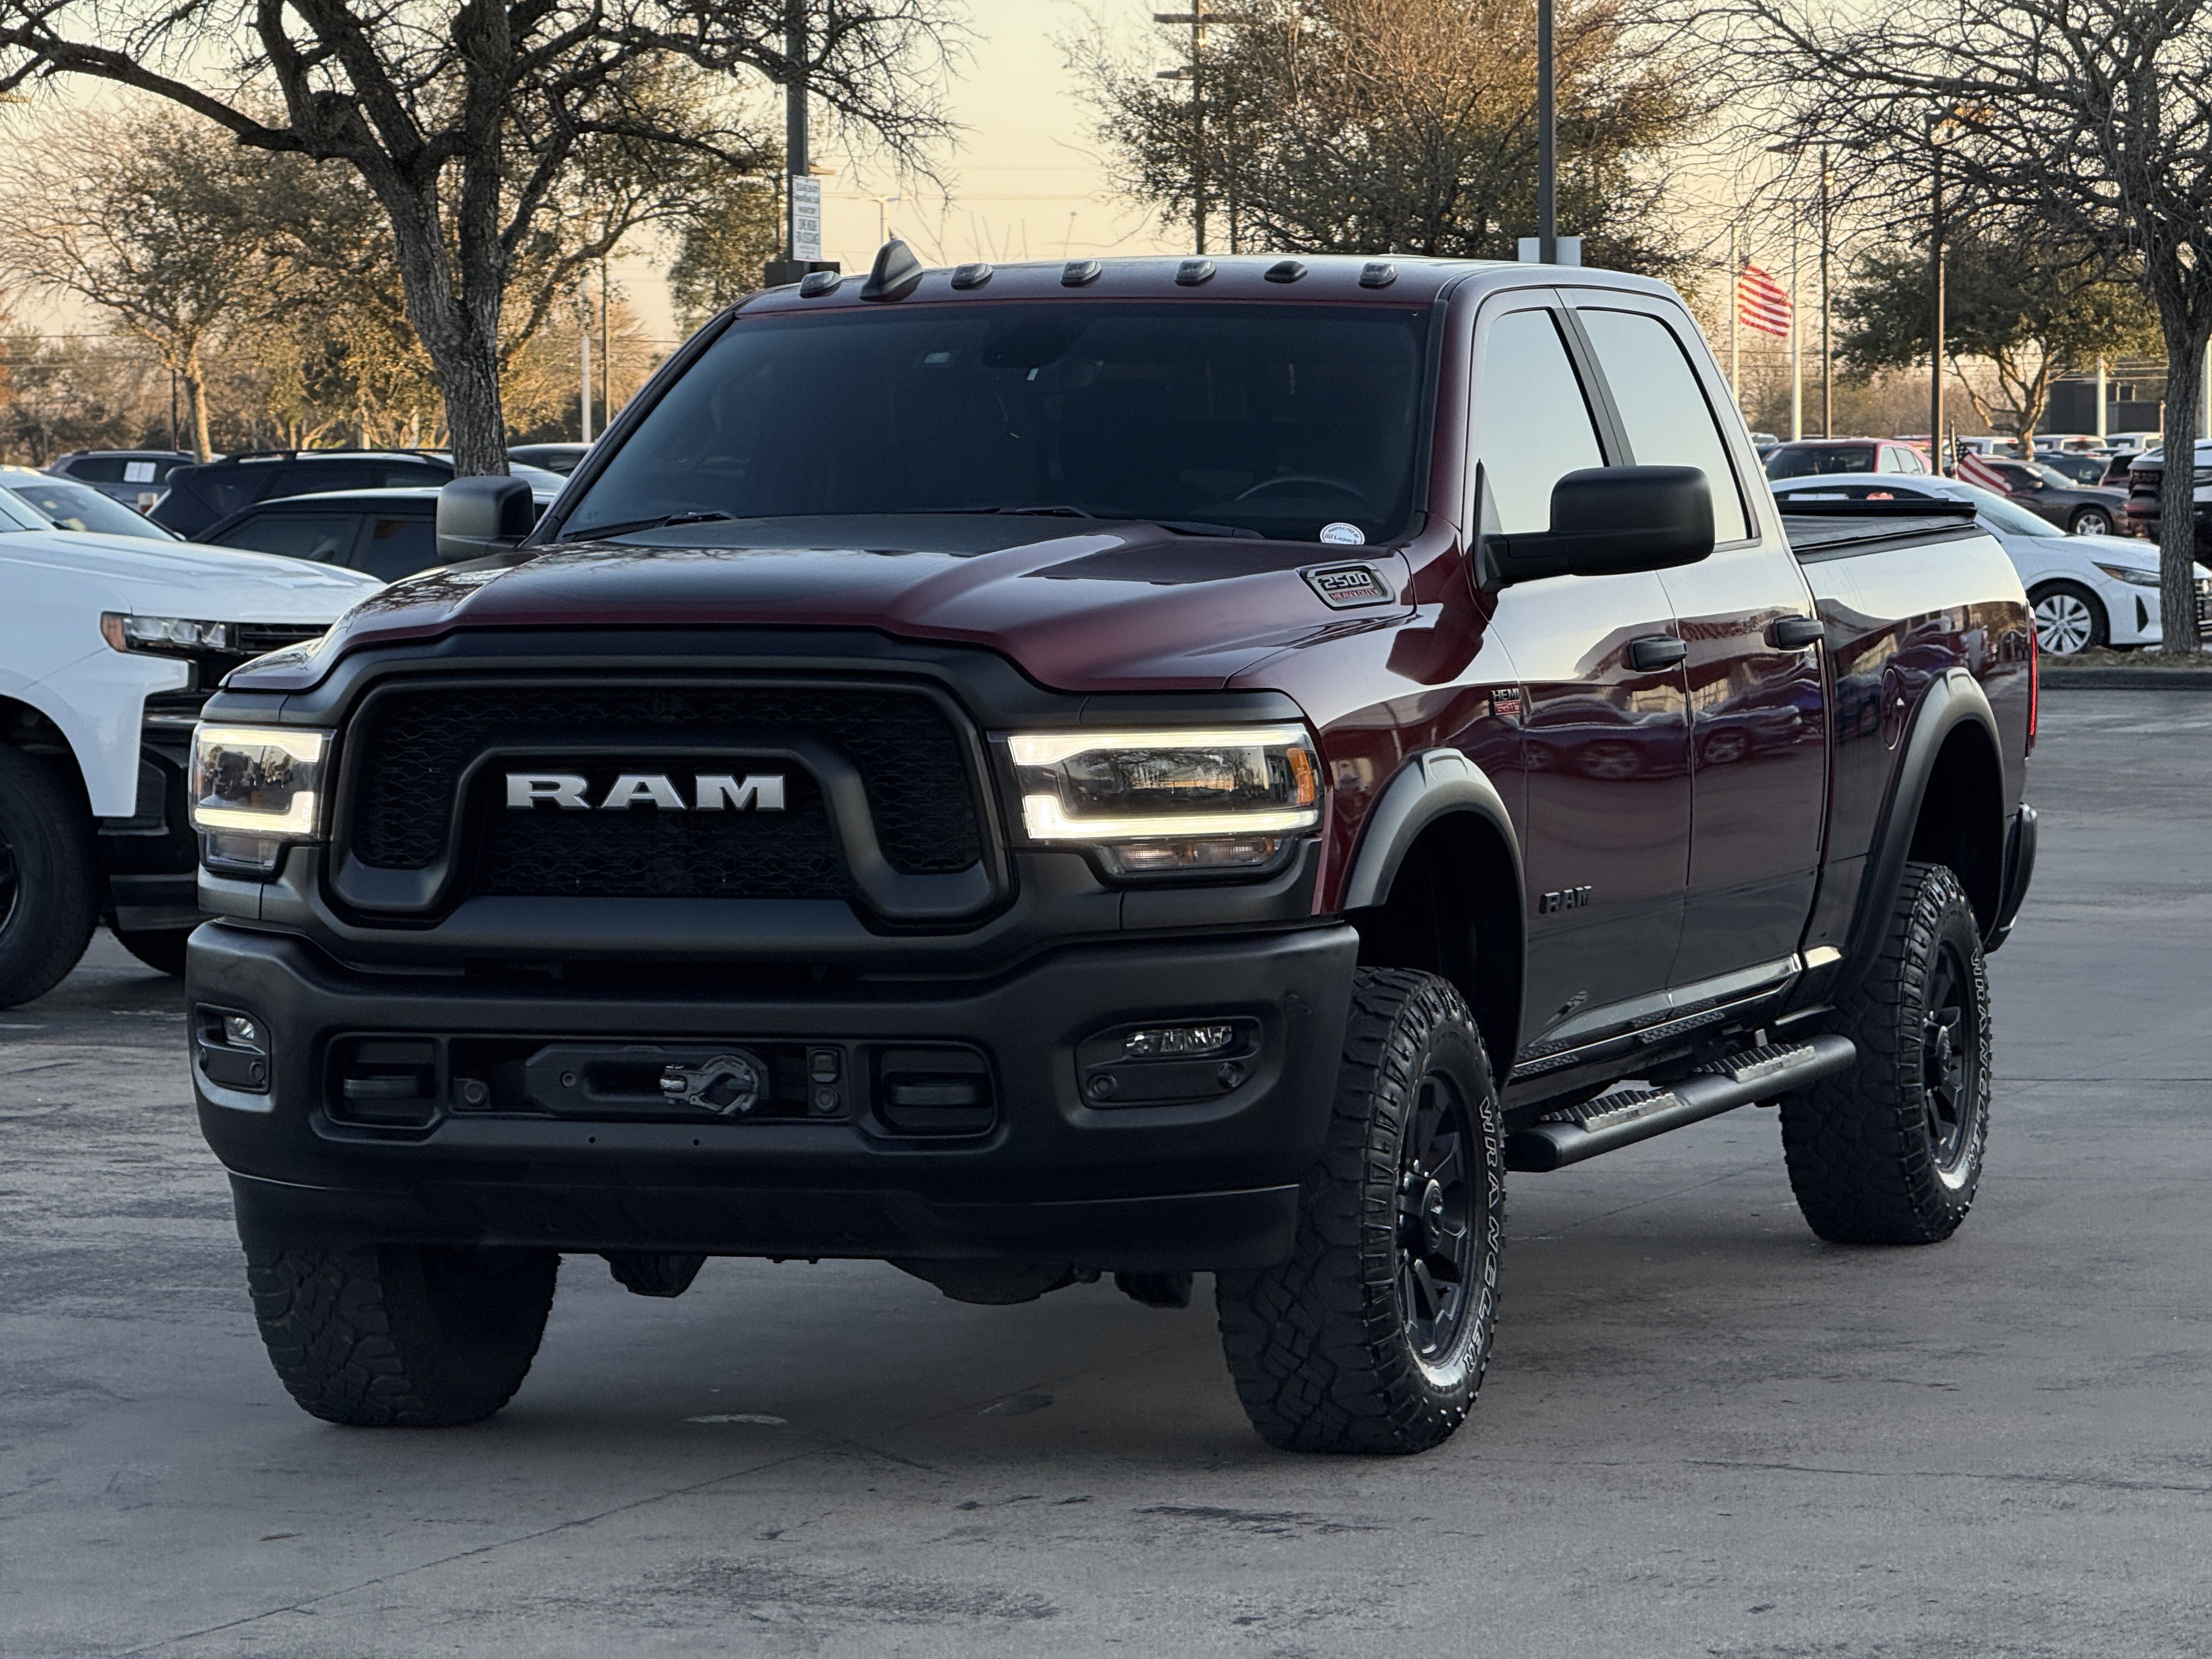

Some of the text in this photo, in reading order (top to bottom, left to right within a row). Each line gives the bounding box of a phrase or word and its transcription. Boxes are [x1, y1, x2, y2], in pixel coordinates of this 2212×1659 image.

[1320, 572, 1372, 590] 2500
[1329, 588, 1379, 600] HEAVY DUTY
[1490, 687, 1520, 702] HEMI
[506, 773, 785, 811] RAM
[1968, 947, 1989, 1170] WRANGLER
[1462, 1096, 1499, 1373] WRANGLER
